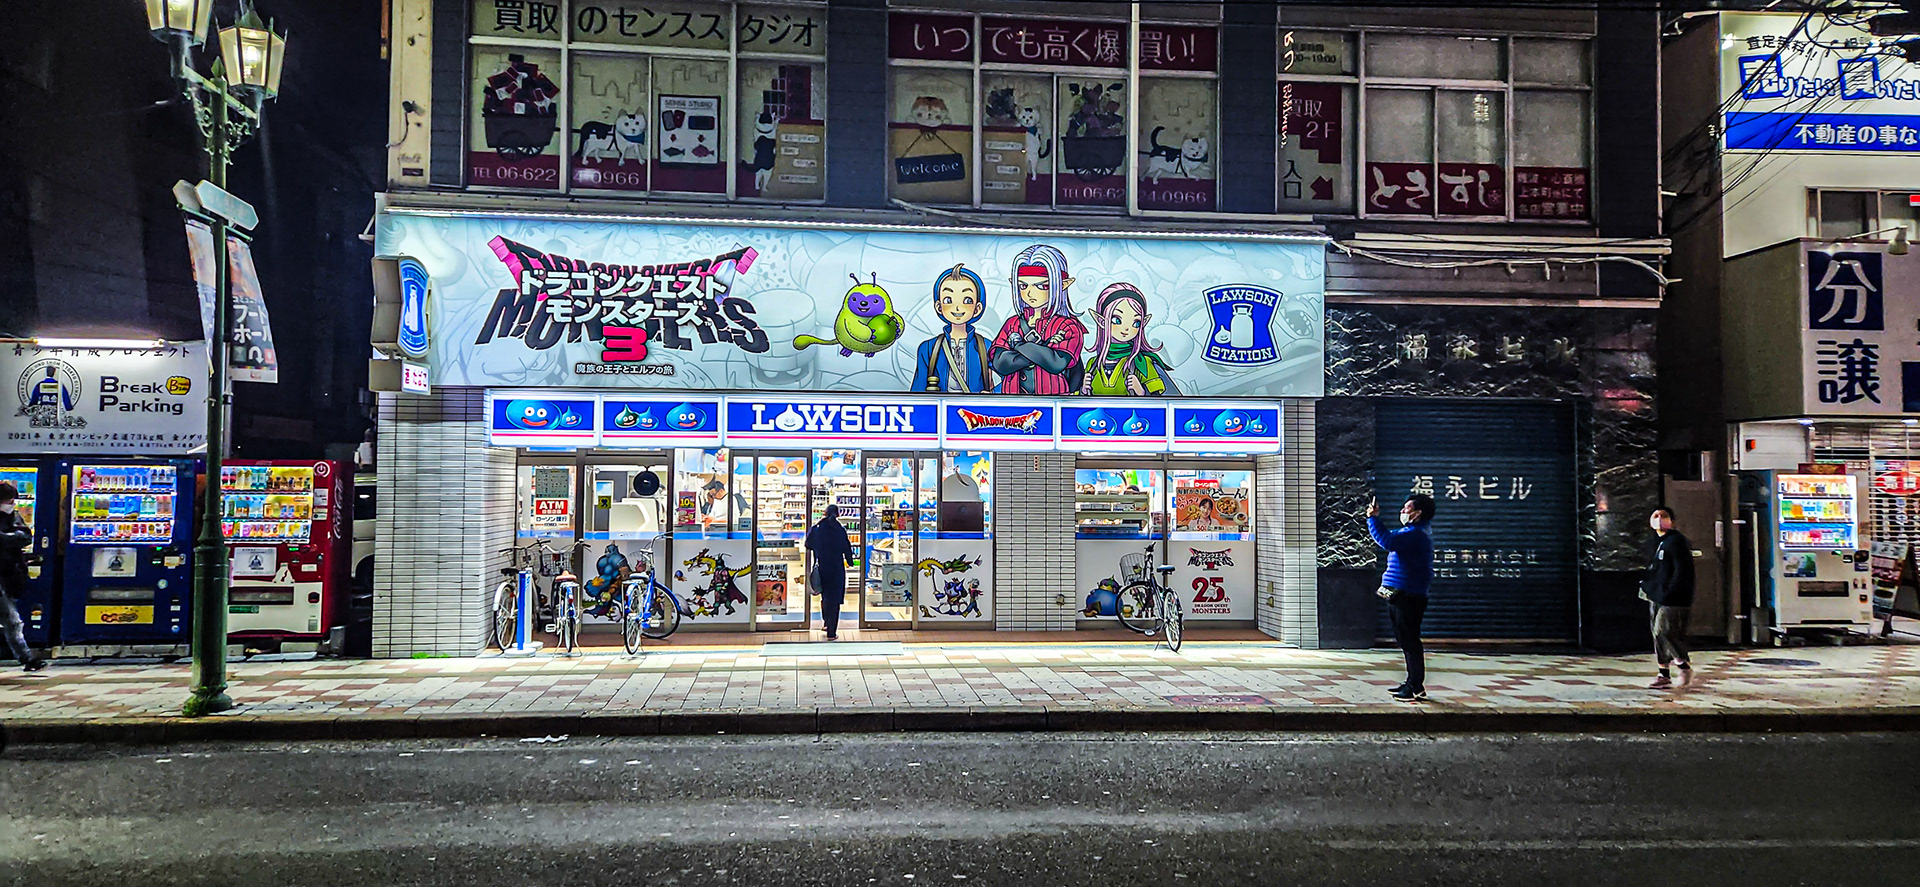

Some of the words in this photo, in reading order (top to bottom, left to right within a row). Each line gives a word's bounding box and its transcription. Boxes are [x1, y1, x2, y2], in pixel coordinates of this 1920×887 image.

[473, 166, 491, 179] TEL
[1283, 160, 1302, 199] 入口
[521, 269, 727, 300] ドラゴンクエスト
[1210, 289, 1276, 307] LAWSON
[545, 299, 706, 327] モンスターズ
[601, 324, 648, 362] 3
[1815, 260, 1881, 404] 分譲
[1210, 346, 1275, 361] STATION
[575, 363, 675, 375] 魔族の王子とエルフの旅
[100, 376, 164, 394] Break
[100, 395, 184, 415] Parking
[751, 404, 915, 433] LWSON
[1411, 475, 1533, 500] 福永ビル
[539, 501, 565, 510] ATM
